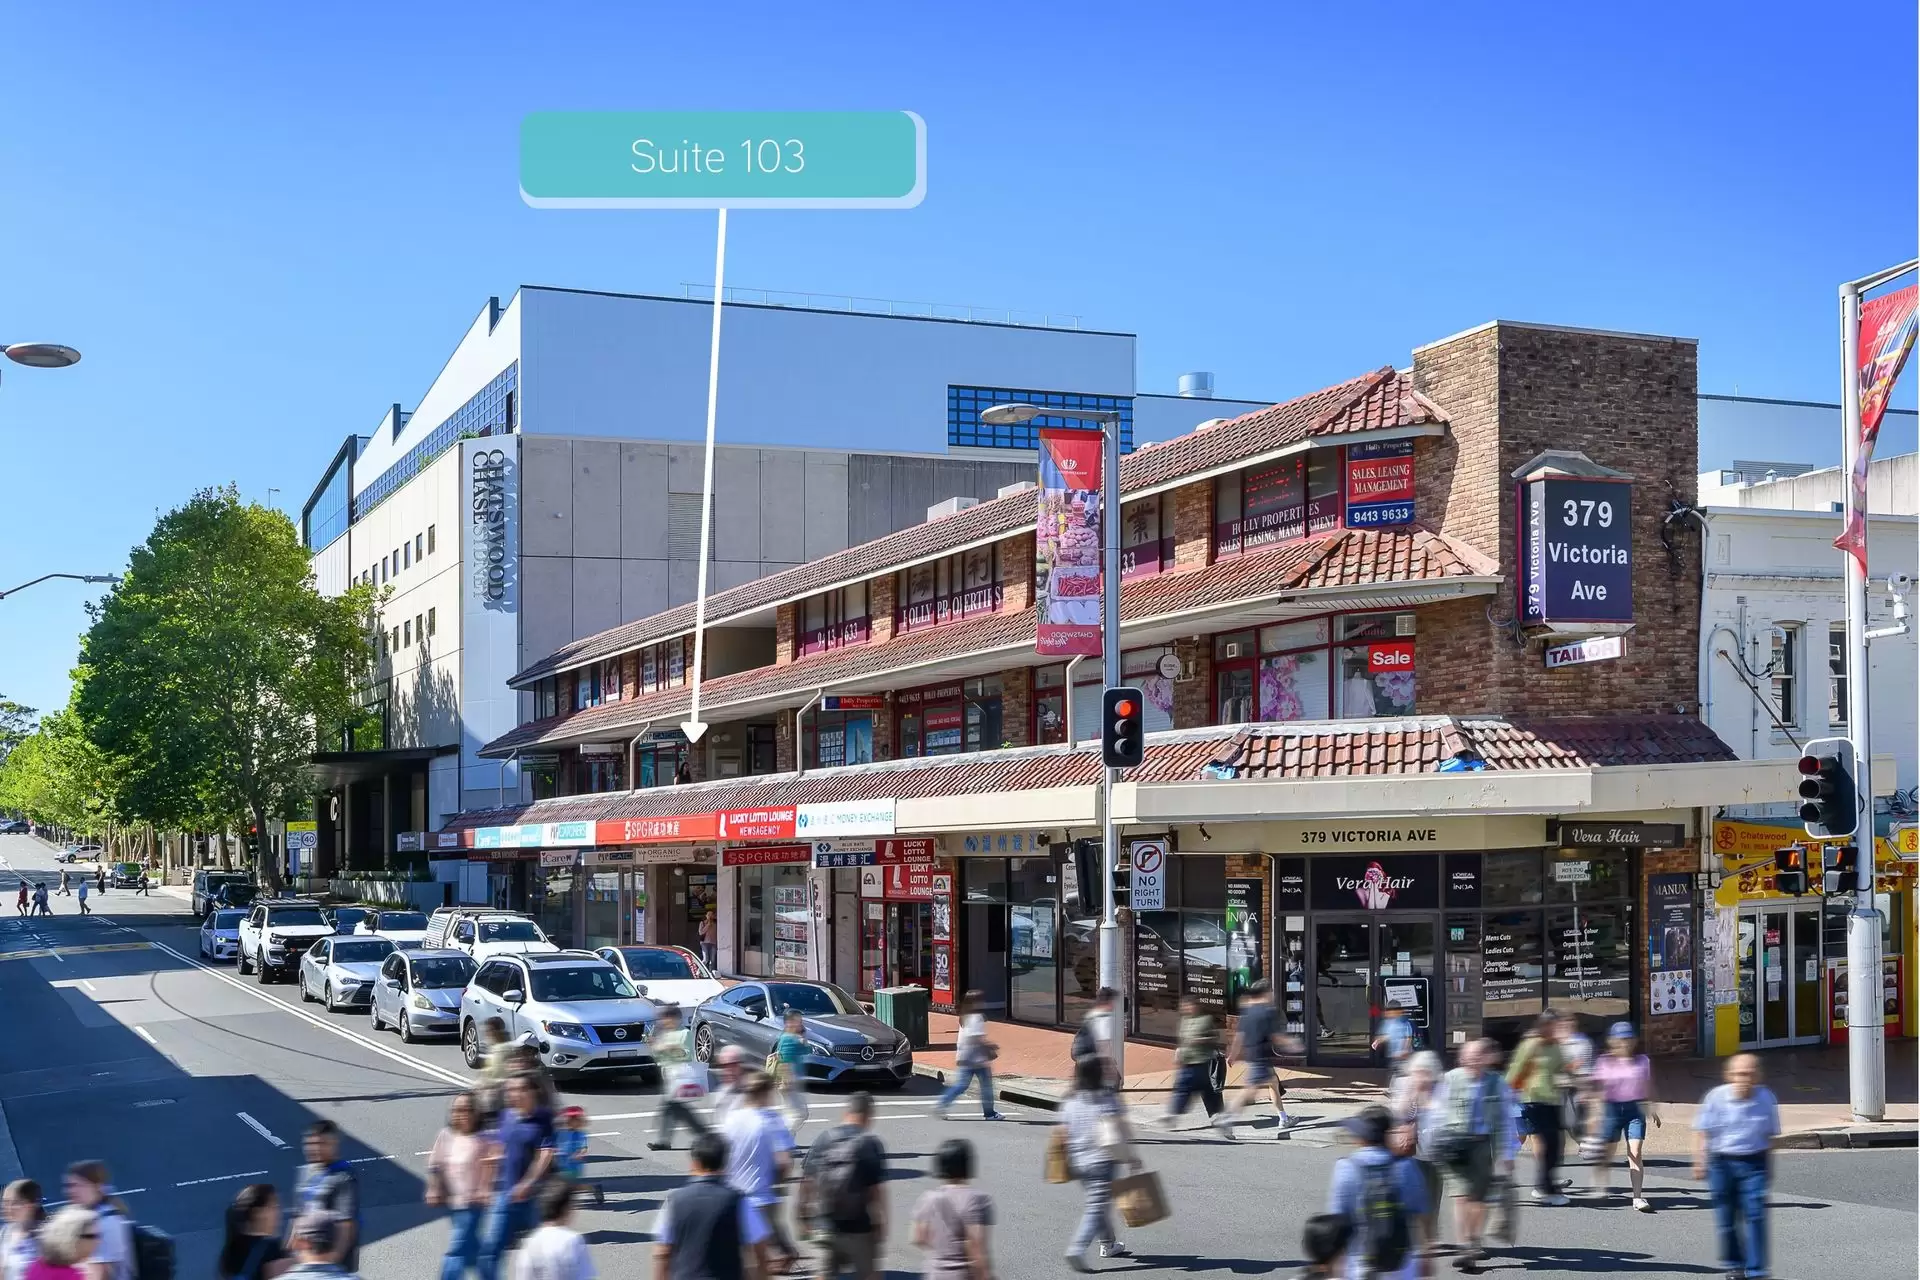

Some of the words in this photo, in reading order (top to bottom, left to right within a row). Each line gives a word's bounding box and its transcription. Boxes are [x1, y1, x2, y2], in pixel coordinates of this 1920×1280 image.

[1377, 464, 1410, 478] LEASING
[472, 451, 489, 525] CHASE
[1354, 478, 1408, 494] MANAGEMENT
[1354, 510, 1378, 523] 9413
[1381, 507, 1408, 521] 9633
[1531, 500, 1540, 531] Ave
[1563, 499, 1613, 528] 379
[488, 448, 505, 600] CHATSWOOD
[1531, 531, 1540, 579] Victoria
[1548, 541, 1628, 565] Victoria
[1570, 579, 1607, 601] Ave
[1529, 583, 1540, 615] 379
[1372, 650, 1411, 666] Sale
[729, 812, 749, 824] LUCKY
[749, 811, 769, 823] LOTTO
[769, 810, 794, 822] LOUNGE
[739, 825, 781, 836] NEWSAGENCY
[1300, 831, 1327, 843] 379
[1331, 830, 1402, 842] VICTORIA
[1406, 829, 1437, 841] AVE
[1571, 828, 1602, 843] Vera
[1606, 828, 1641, 843] Hair
[1740, 831, 1787, 841] Chatswood
[903, 840, 926, 848] LUCKY
[903, 855, 931, 863] LOUNGE
[909, 875, 929, 884] LOTTO
[1138, 875, 1157, 887] NO
[1335, 876, 1372, 890] Vera
[1378, 875, 1415, 889] Hair
[909, 887, 934, 896] LOUNGE
[1134, 888, 1161, 897] RIGHT
[1135, 898, 1160, 907] TURN
[1562, 941, 1579, 949] Organic
